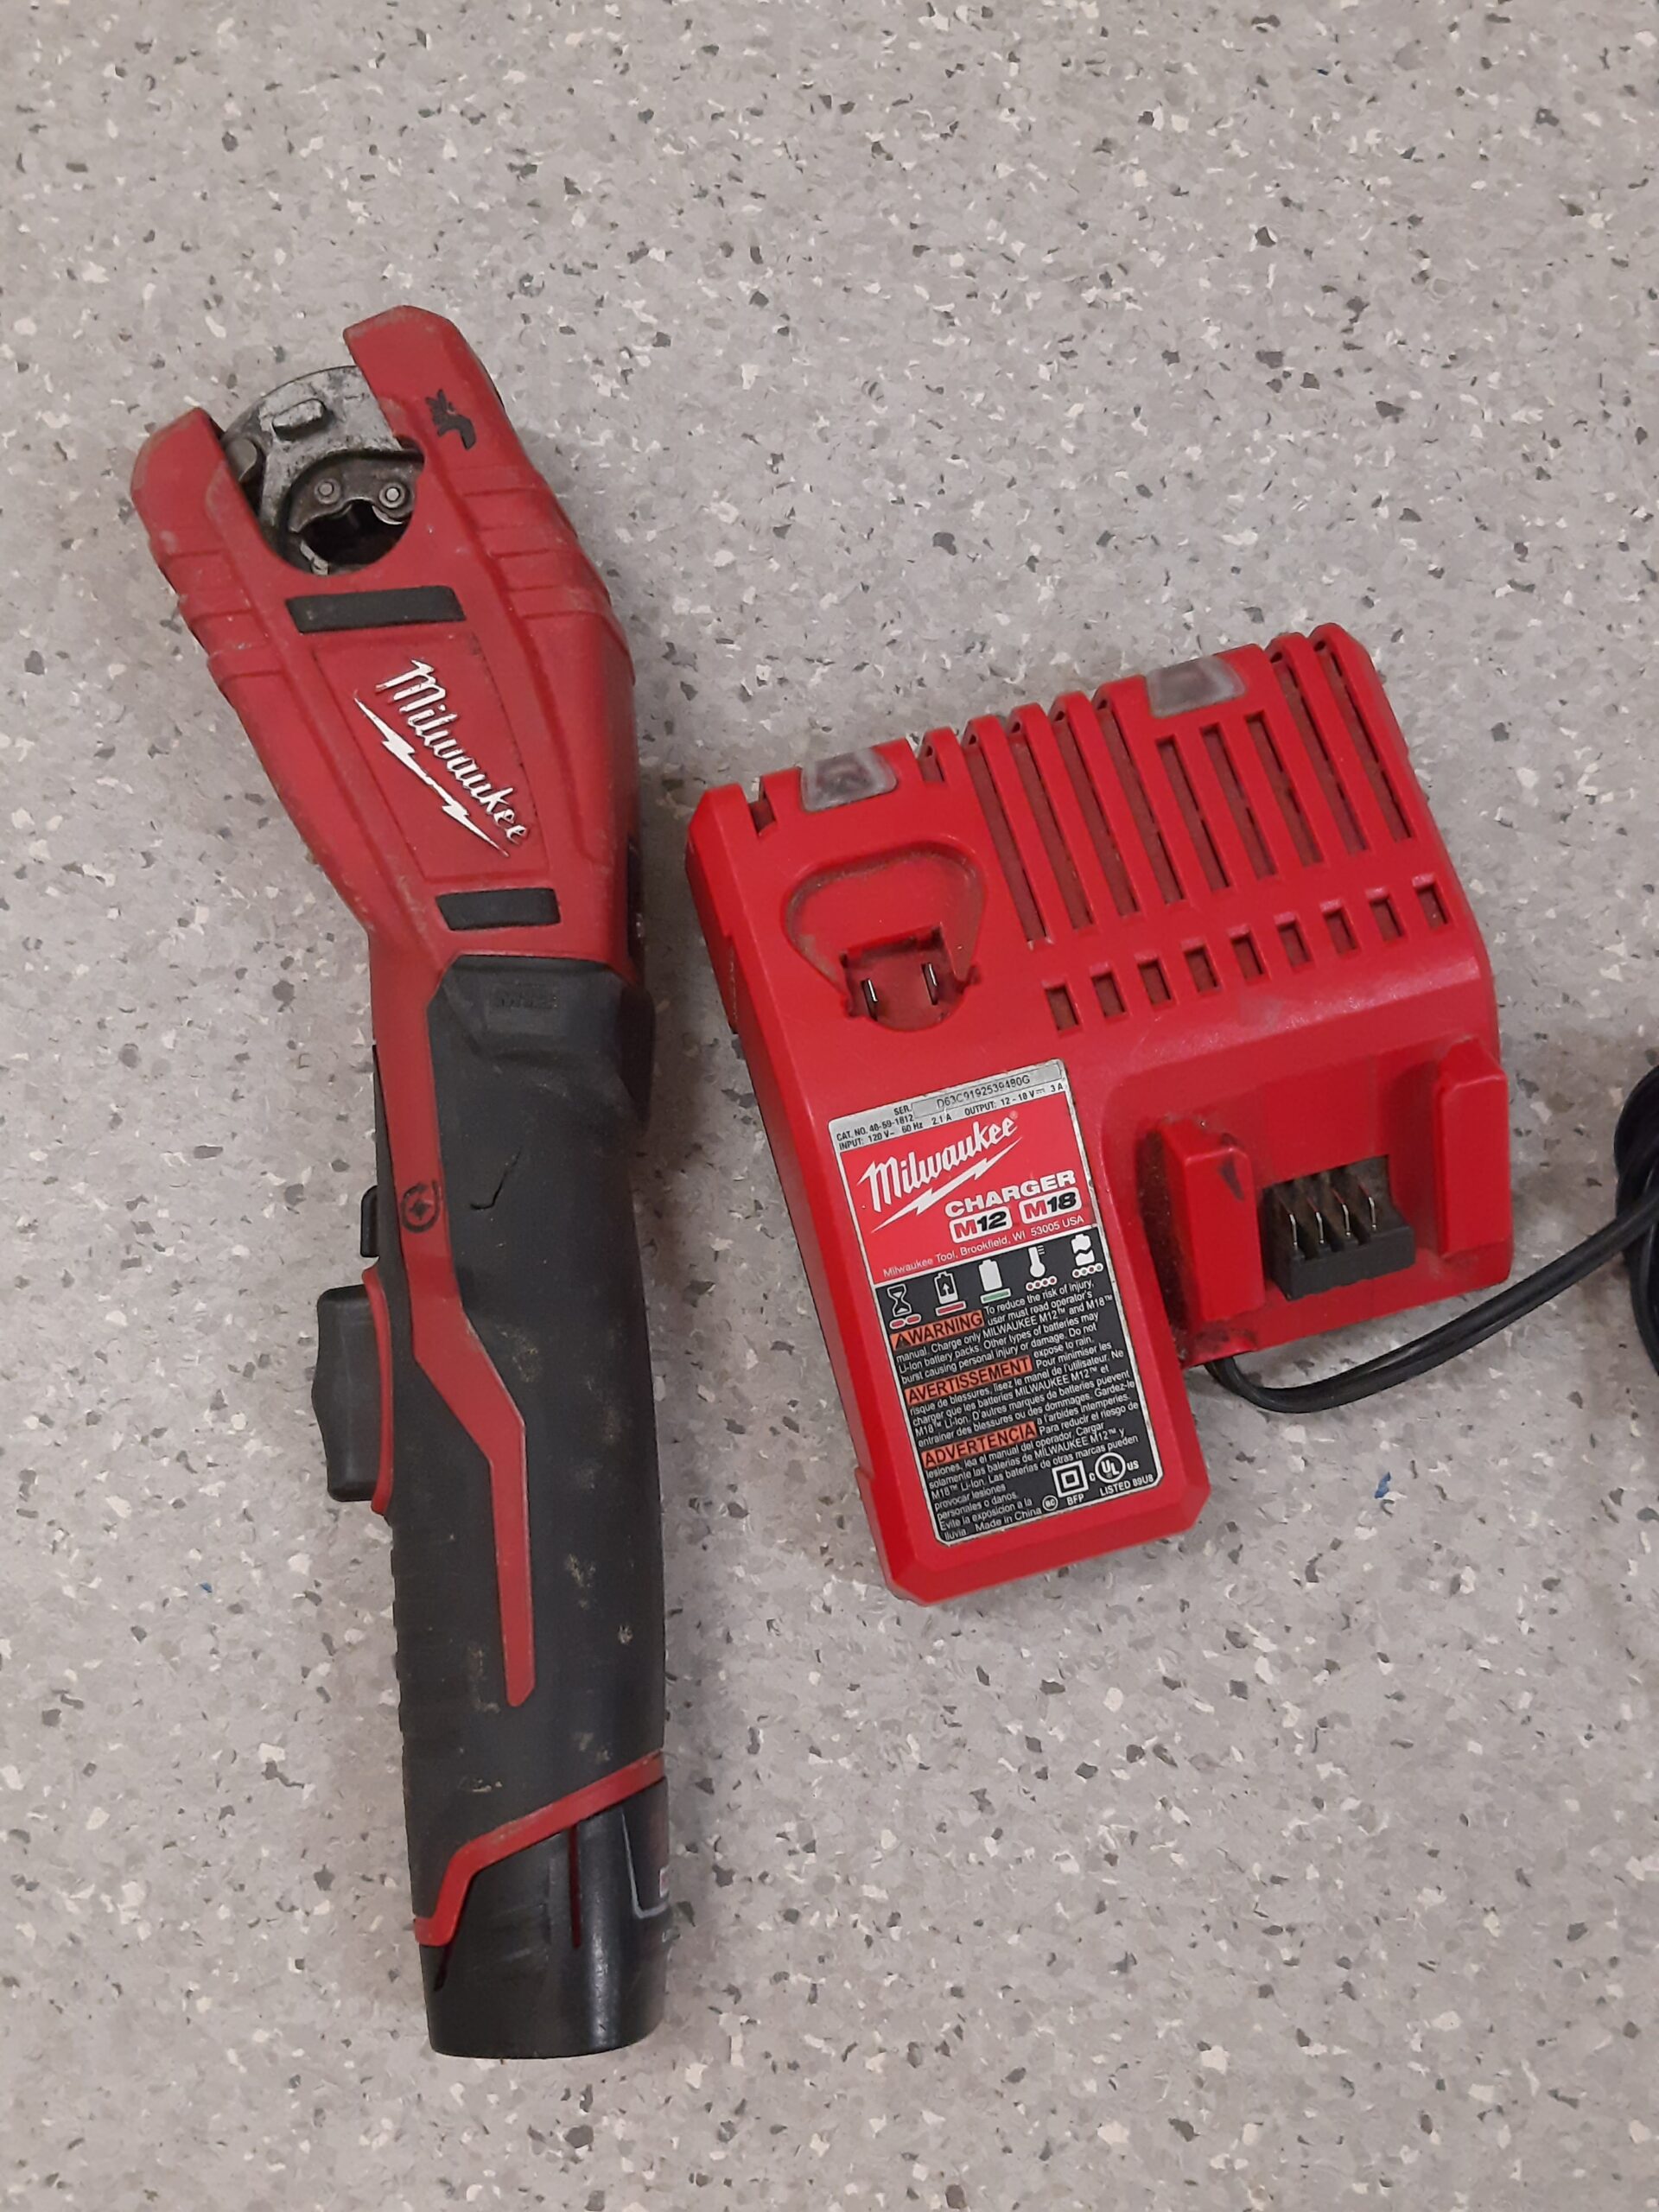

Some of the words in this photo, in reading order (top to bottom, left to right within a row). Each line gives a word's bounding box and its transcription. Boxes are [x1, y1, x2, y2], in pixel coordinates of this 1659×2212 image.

[375, 659, 527, 844] Milwaukee
[868, 1132, 882, 1141] 120
[901, 1124, 912, 1133] 60
[1001, 1096, 1010, 1105] 12
[946, 1171, 1074, 1216] CHARGER
[953, 1209, 1008, 1239] M12
[1021, 1190, 1077, 1219] M18
[883, 1258, 932, 1276] Milwaukee
[960, 1236, 1010, 1255] Brookfield,
[1012, 1230, 1026, 1241] WI
[1030, 1221, 1059, 1236] 53005
[1062, 1215, 1084, 1227] USA
[983, 1305, 995, 1315] To
[996, 1298, 1025, 1312] reduce
[1027, 1294, 1040, 1303] the
[1042, 1287, 1058, 1299] risk
[1058, 1284, 1067, 1294] of
[987, 1314, 1005, 1325] user
[1007, 1307, 1028, 1320] must
[908, 1313, 982, 1343] WARNING
[924, 1352, 952, 1366] battery
[983, 1337, 1007, 1349] Other
[1008, 1330, 1032, 1344] types
[1033, 1325, 1041, 1336] of
[1043, 1317, 1078, 1332] batteries
[1080, 1312, 1098, 1322] may
[931, 1338, 962, 1352] Charge
[963, 1332, 981, 1344] only
[982, 1315, 1037, 1338] MILWAUKEE
[1069, 1302, 1084, 1314] and
[900, 1371, 923, 1384] burst
[925, 1363, 957, 1377] causing
[958, 1351, 994, 1370] personal
[995, 1345, 1018, 1357] injury
[1020, 1342, 1028, 1351] or
[1068, 1327, 1081, 1337] Do
[1083, 1322, 1096, 1333] not
[1033, 1344, 1064, 1357] expose
[1035, 1357, 1055, 1369] Pour
[1058, 1345, 1096, 1362] minimiser
[1098, 1342, 1111, 1351] les
[909, 1357, 1027, 1402] AVERTISSEMENT
[910, 1402, 935, 1415] risque
[937, 1398, 948, 1408] de
[1014, 1377, 1022, 1386] le
[1051, 1366, 1062, 1376] de
[1110, 1349, 1123, 1358] Ne
[912, 1411, 944, 1427] charger
[945, 1407, 962, 1418] que
[963, 1402, 976, 1411] les
[977, 1392, 1013, 1408] batteries
[1014, 1374, 1068, 1396] MILWAUKEE
[1100, 1364, 1109, 1373] et
[1008, 1394, 1045, 1410] marques
[1046, 1389, 1057, 1400] de
[1058, 1381, 1094, 1395] batteries
[956, 1426, 972, 1436] des
[1014, 1411, 1026, 1420] ou
[1027, 1406, 1043, 1416] des
[1039, 1424, 1058, 1435] Para
[1060, 1414, 1088, 1429] reducir
[1090, 1411, 1099, 1421] el
[1127, 1401, 1138, 1410] de
[925, 1422, 1034, 1467] ADVERTENCIA
[972, 1466, 985, 1477] las
[1021, 1453, 1033, 1462] de
[1034, 1436, 1088, 1458] MILWAUKEE
[1118, 1427, 1124, 1437] y
[978, 1453, 987, 1464] el
[988, 1445, 1019, 1460] manual
[1020, 1440, 1033, 1452] del
[1076, 1422, 1103, 1439] Cargar
[988, 1473, 1003, 1484] Las
[1039, 1459, 1051, 1469] de
[1052, 1453, 1073, 1465] otras
[1075, 1445, 1105, 1459] marcas
[1107, 1435, 1138, 1451] pueden
[934, 1493, 969, 1511] provocar
[971, 1484, 1006, 1498] lesiones
[1066, 1493, 1084, 1505] BFP
[1099, 1480, 1130, 1496] LISTED
[937, 1502, 982, 1521] personales
[962, 1516, 970, 1524] la
[1023, 1497, 1032, 1506] la
[975, 1519, 1001, 1531] Made
[1014, 1507, 1041, 1520] China
